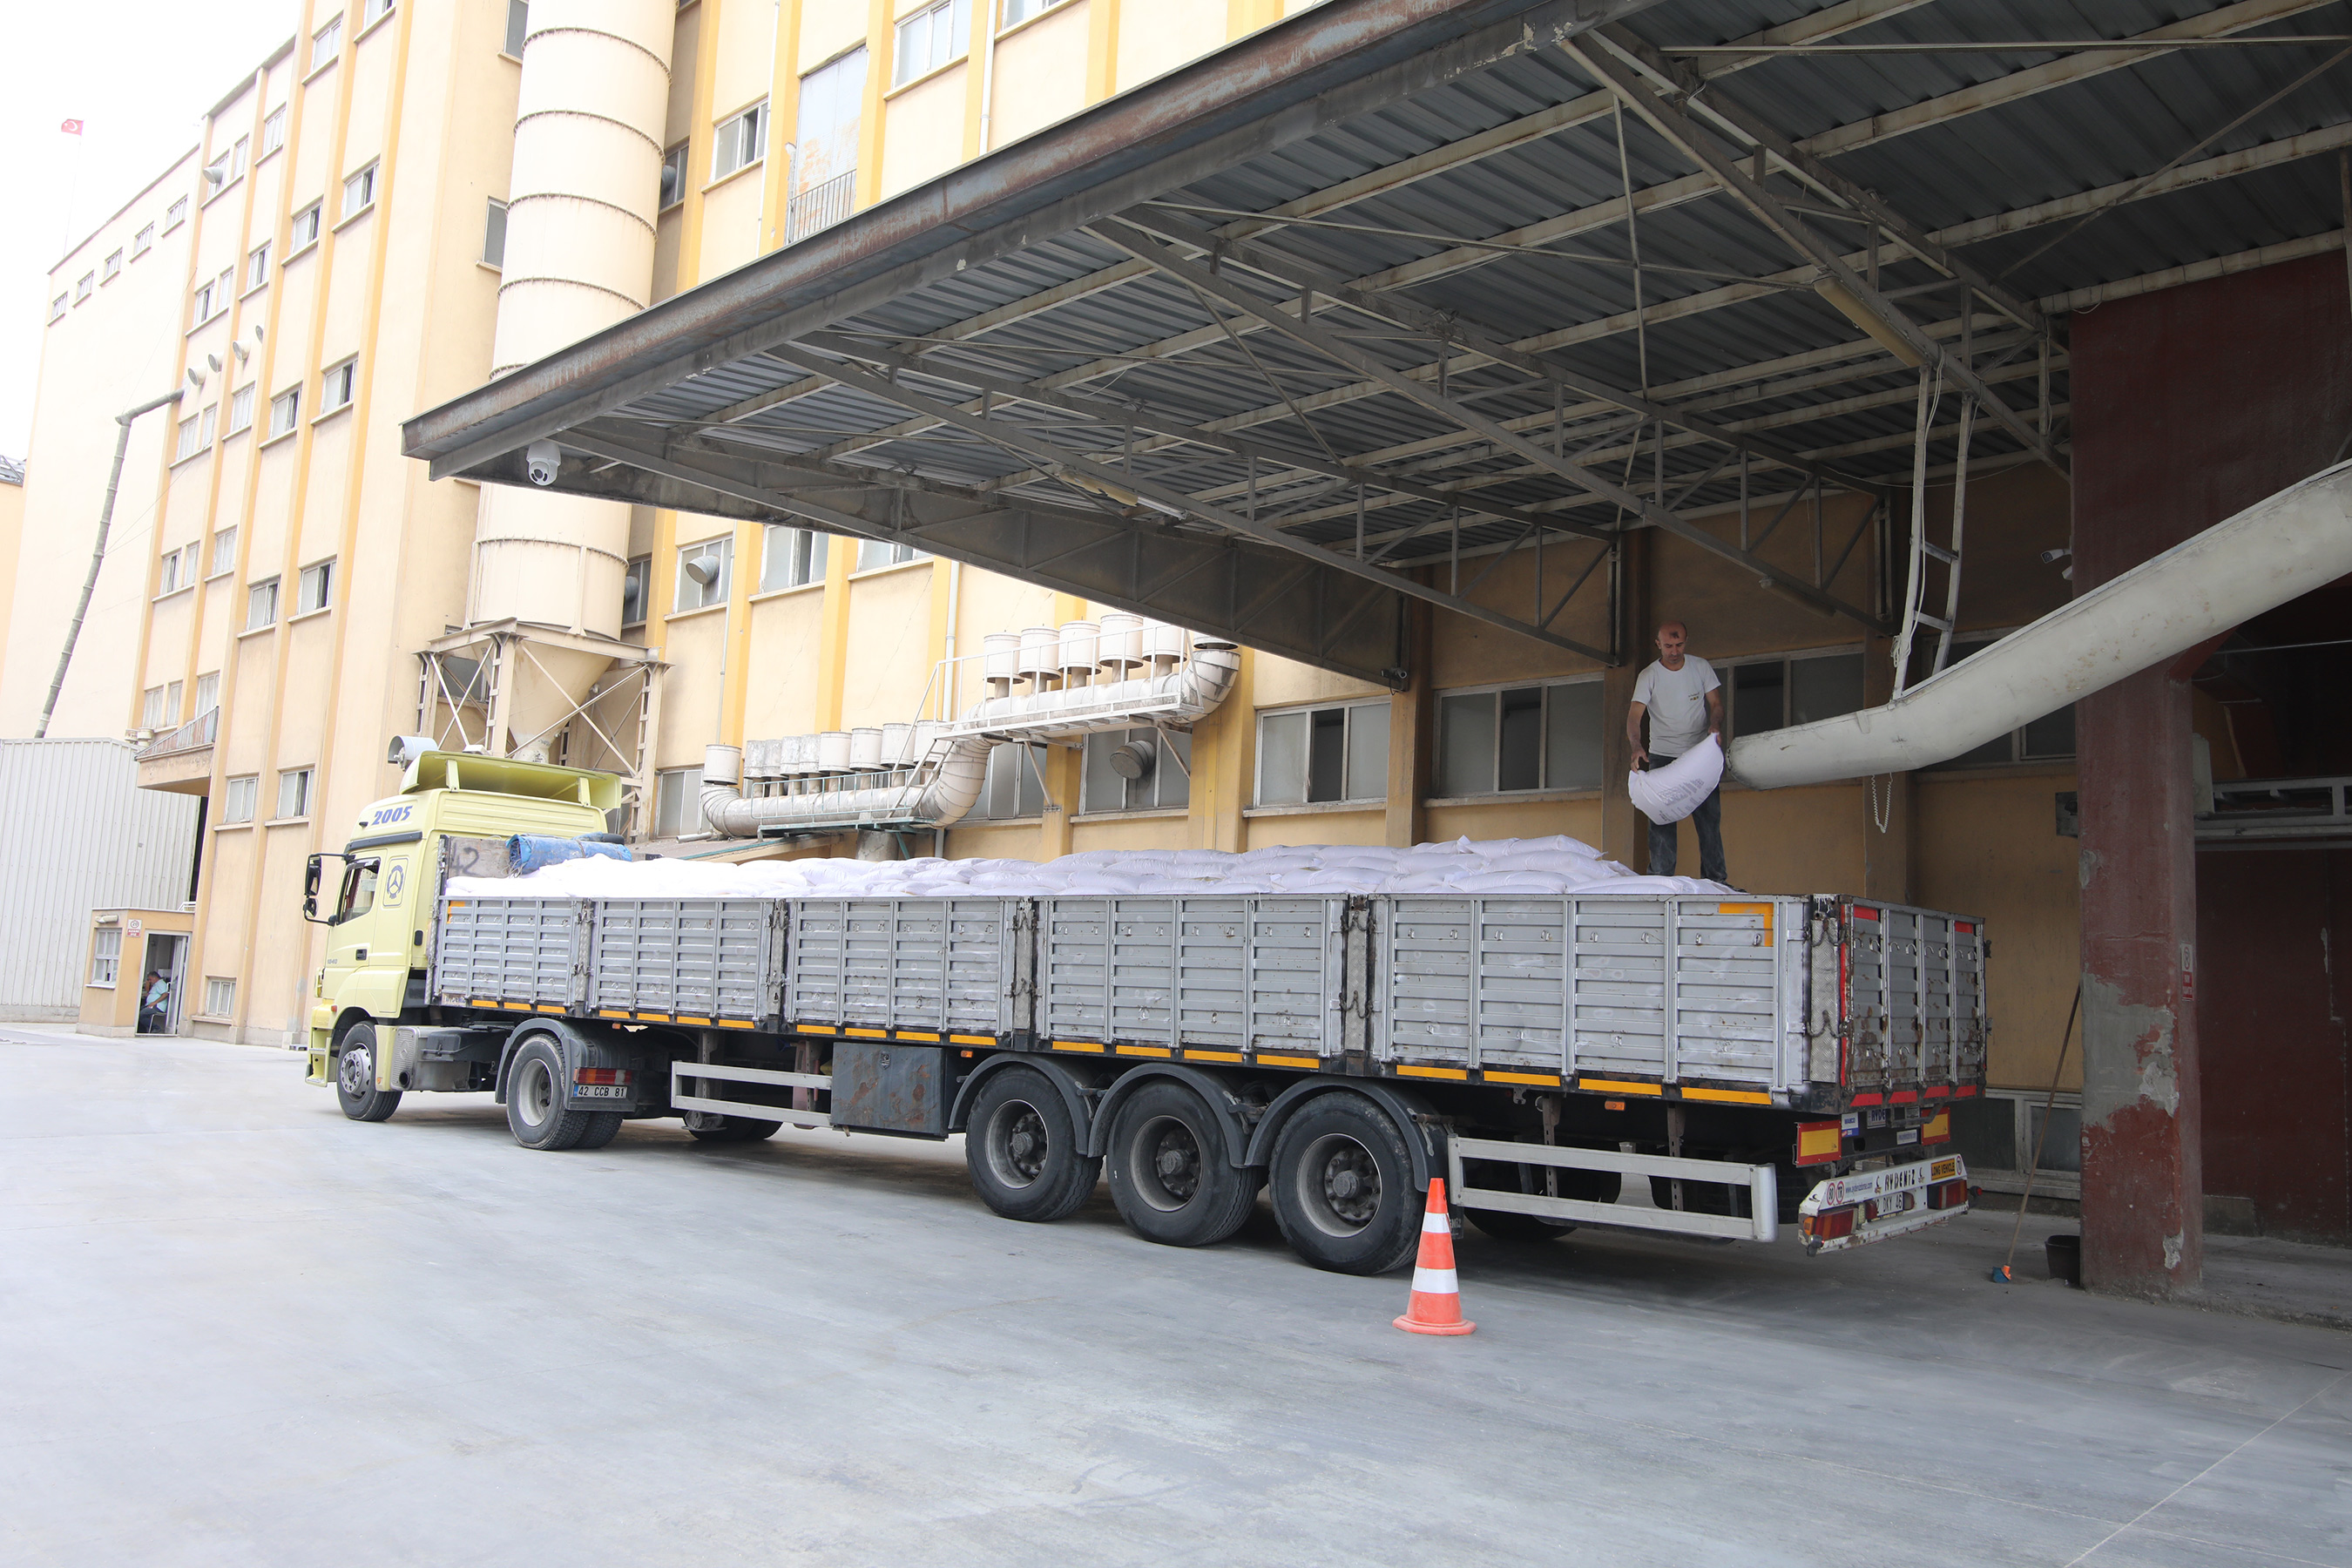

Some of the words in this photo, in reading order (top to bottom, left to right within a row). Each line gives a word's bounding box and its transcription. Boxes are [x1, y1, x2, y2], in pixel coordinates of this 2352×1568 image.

[371, 806, 413, 826] 2005
[578, 1085, 589, 1096] 42
[594, 1086, 609, 1097] CCB
[614, 1087, 624, 1097] 81
[1871, 1108, 1886, 1121] AYDE
[1931, 1165, 1941, 1176] LONG
[1941, 1162, 1955, 1174] VEHICLE
[1882, 1196, 1893, 1213] DKY
[1896, 1193, 1903, 1209] 46
